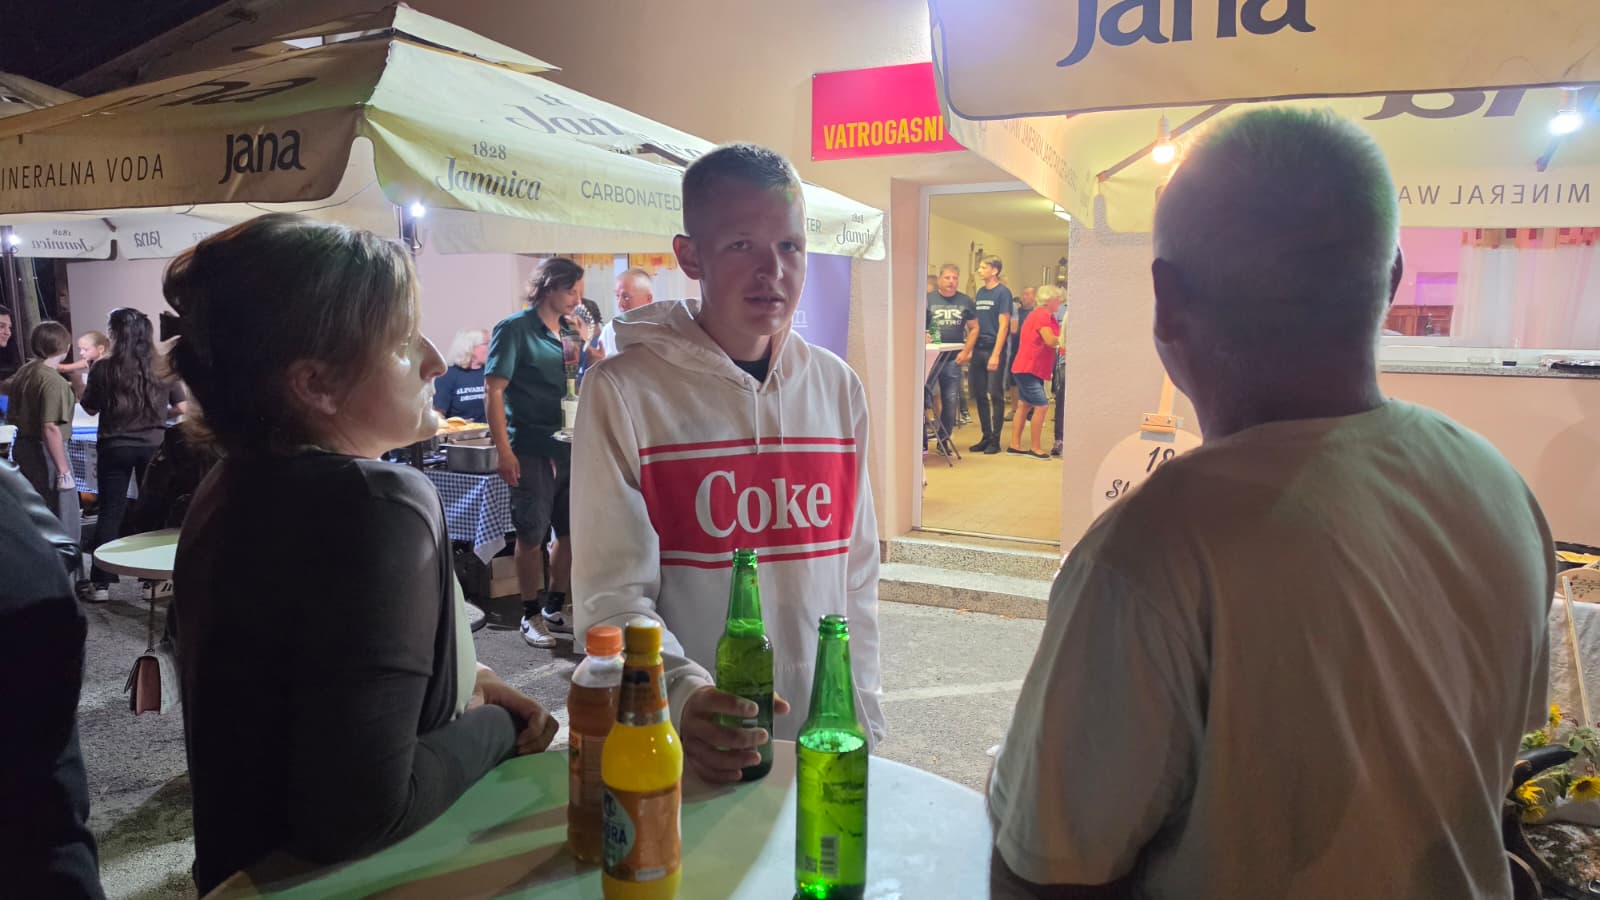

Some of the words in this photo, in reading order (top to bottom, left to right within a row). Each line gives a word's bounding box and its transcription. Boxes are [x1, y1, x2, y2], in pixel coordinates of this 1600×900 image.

[823, 115, 944, 150] VATROGASNI
[472, 141, 507, 160] 1828
[107, 153, 164, 183] VODA
[435, 156, 542, 201] Jamnica
[581, 180, 682, 211] CARBONATED
[695, 470, 832, 538] Coke
